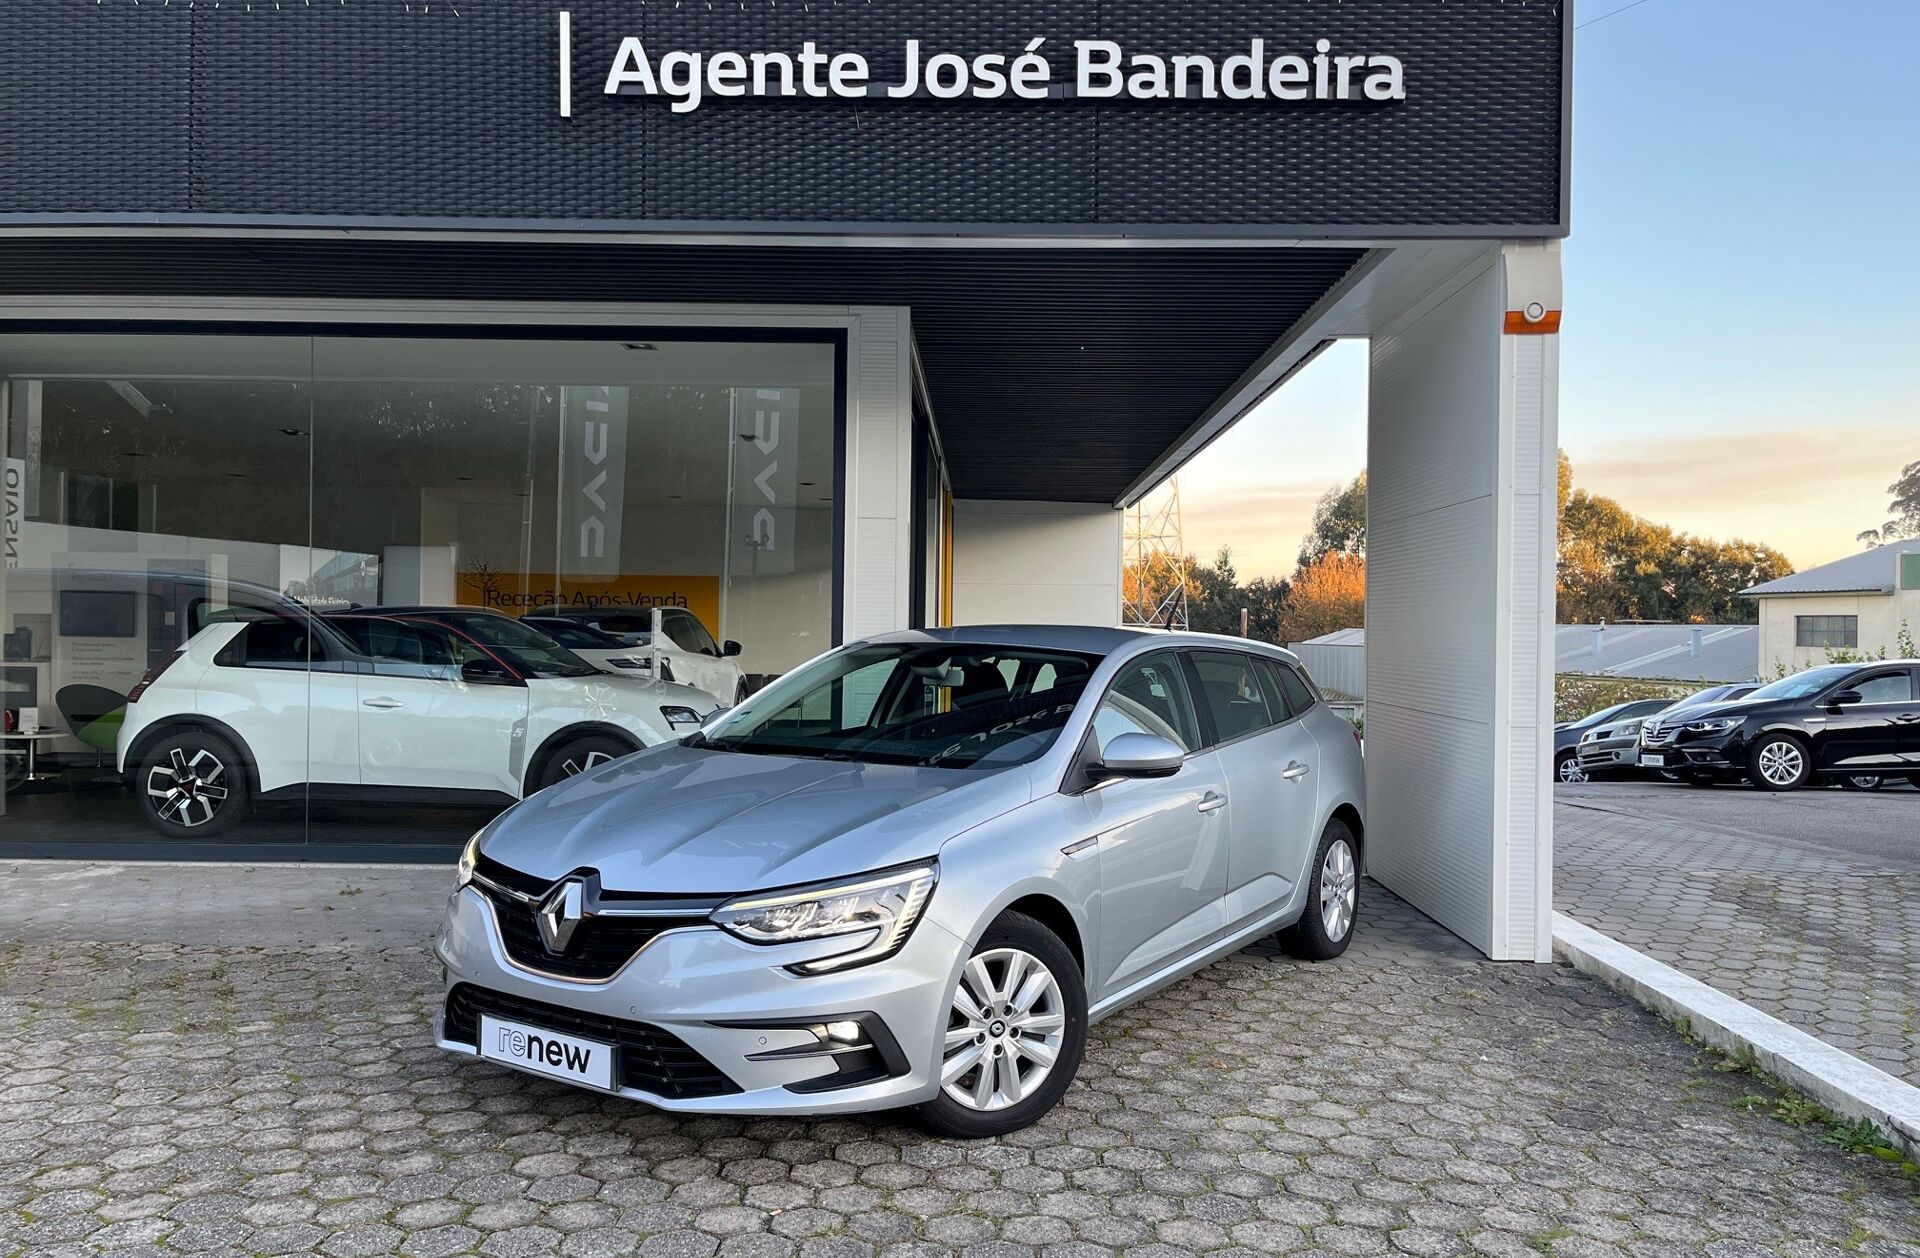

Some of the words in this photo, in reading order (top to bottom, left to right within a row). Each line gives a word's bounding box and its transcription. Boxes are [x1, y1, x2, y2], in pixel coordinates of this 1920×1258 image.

[604, 36, 868, 114] Agente
[888, 36, 1050, 98] José
[1074, 37, 1405, 101] Bandeira
[498, 1027, 591, 1074] renew
